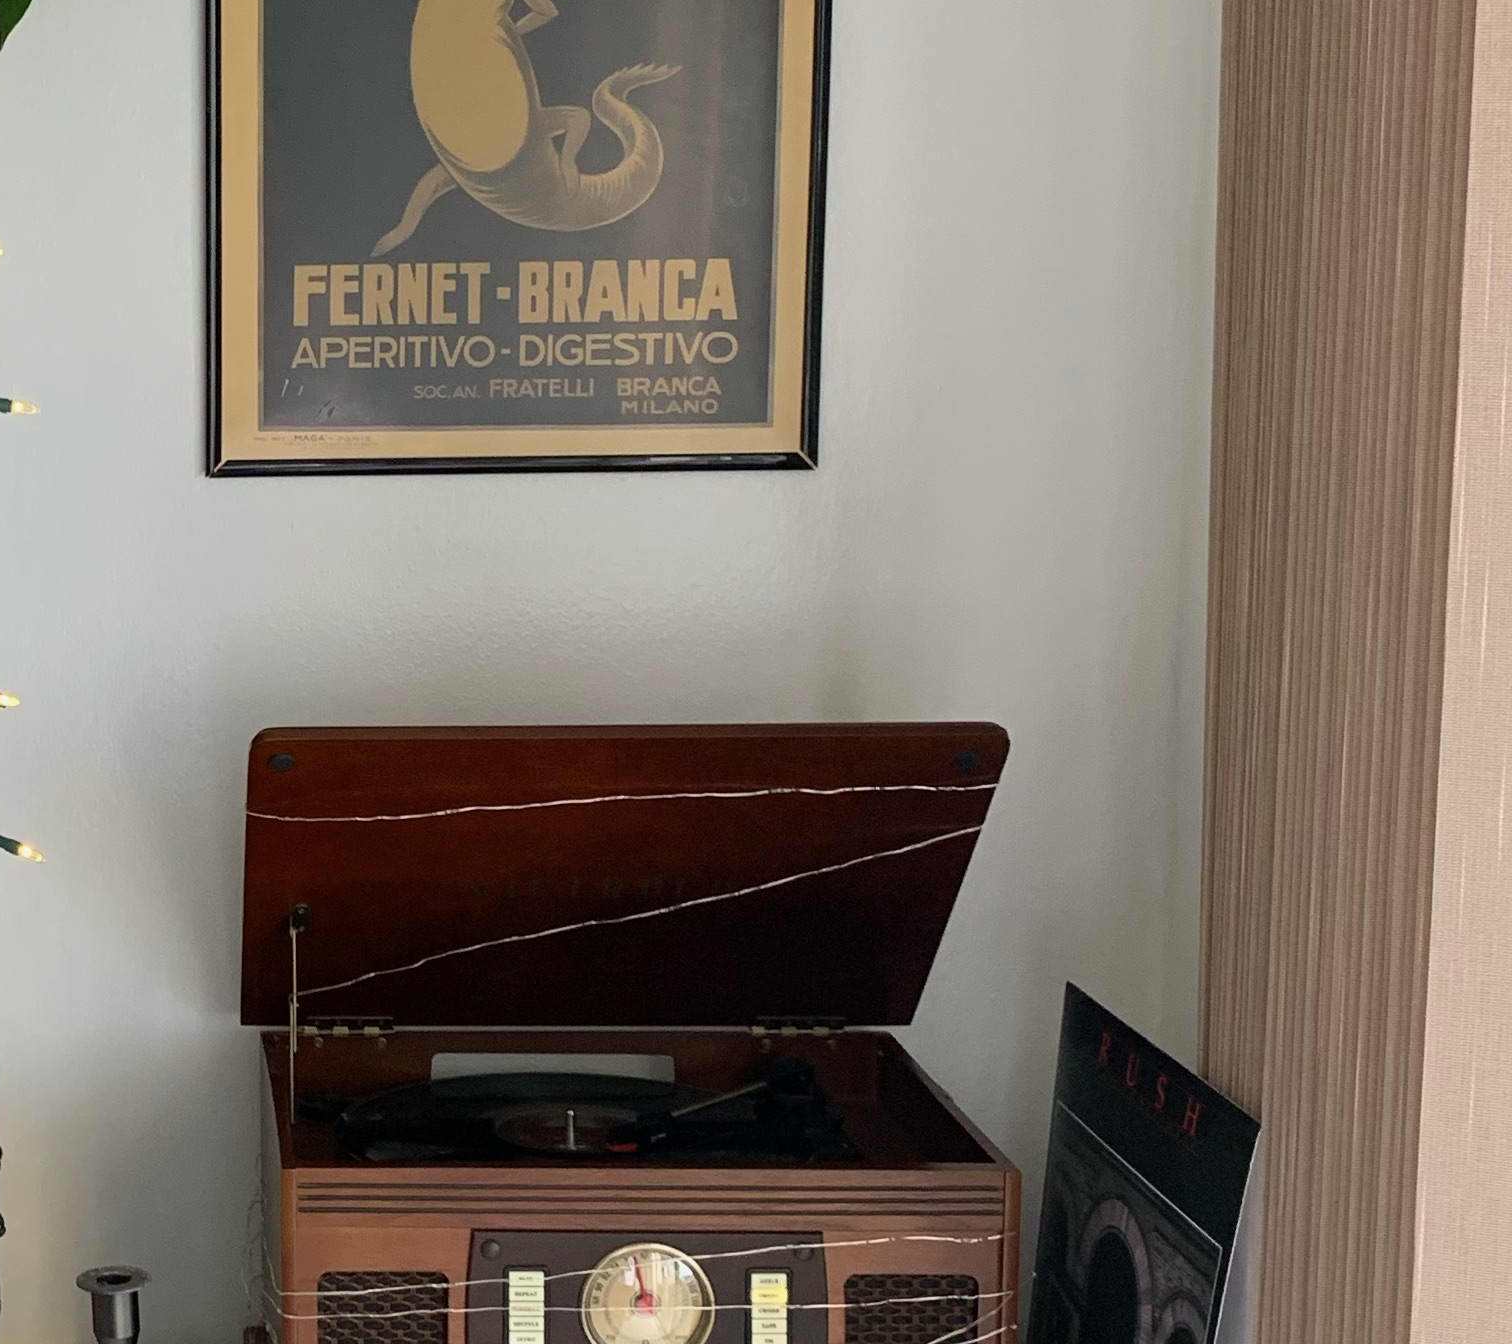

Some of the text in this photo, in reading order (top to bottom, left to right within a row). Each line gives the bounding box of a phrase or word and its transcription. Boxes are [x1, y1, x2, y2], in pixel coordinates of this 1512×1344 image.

[490, 379, 595, 399] FRATELLI
[618, 377, 721, 396] BRANCA
[621, 399, 718, 415] MILANO
[1098, 1031, 1202, 1137] RUSH
